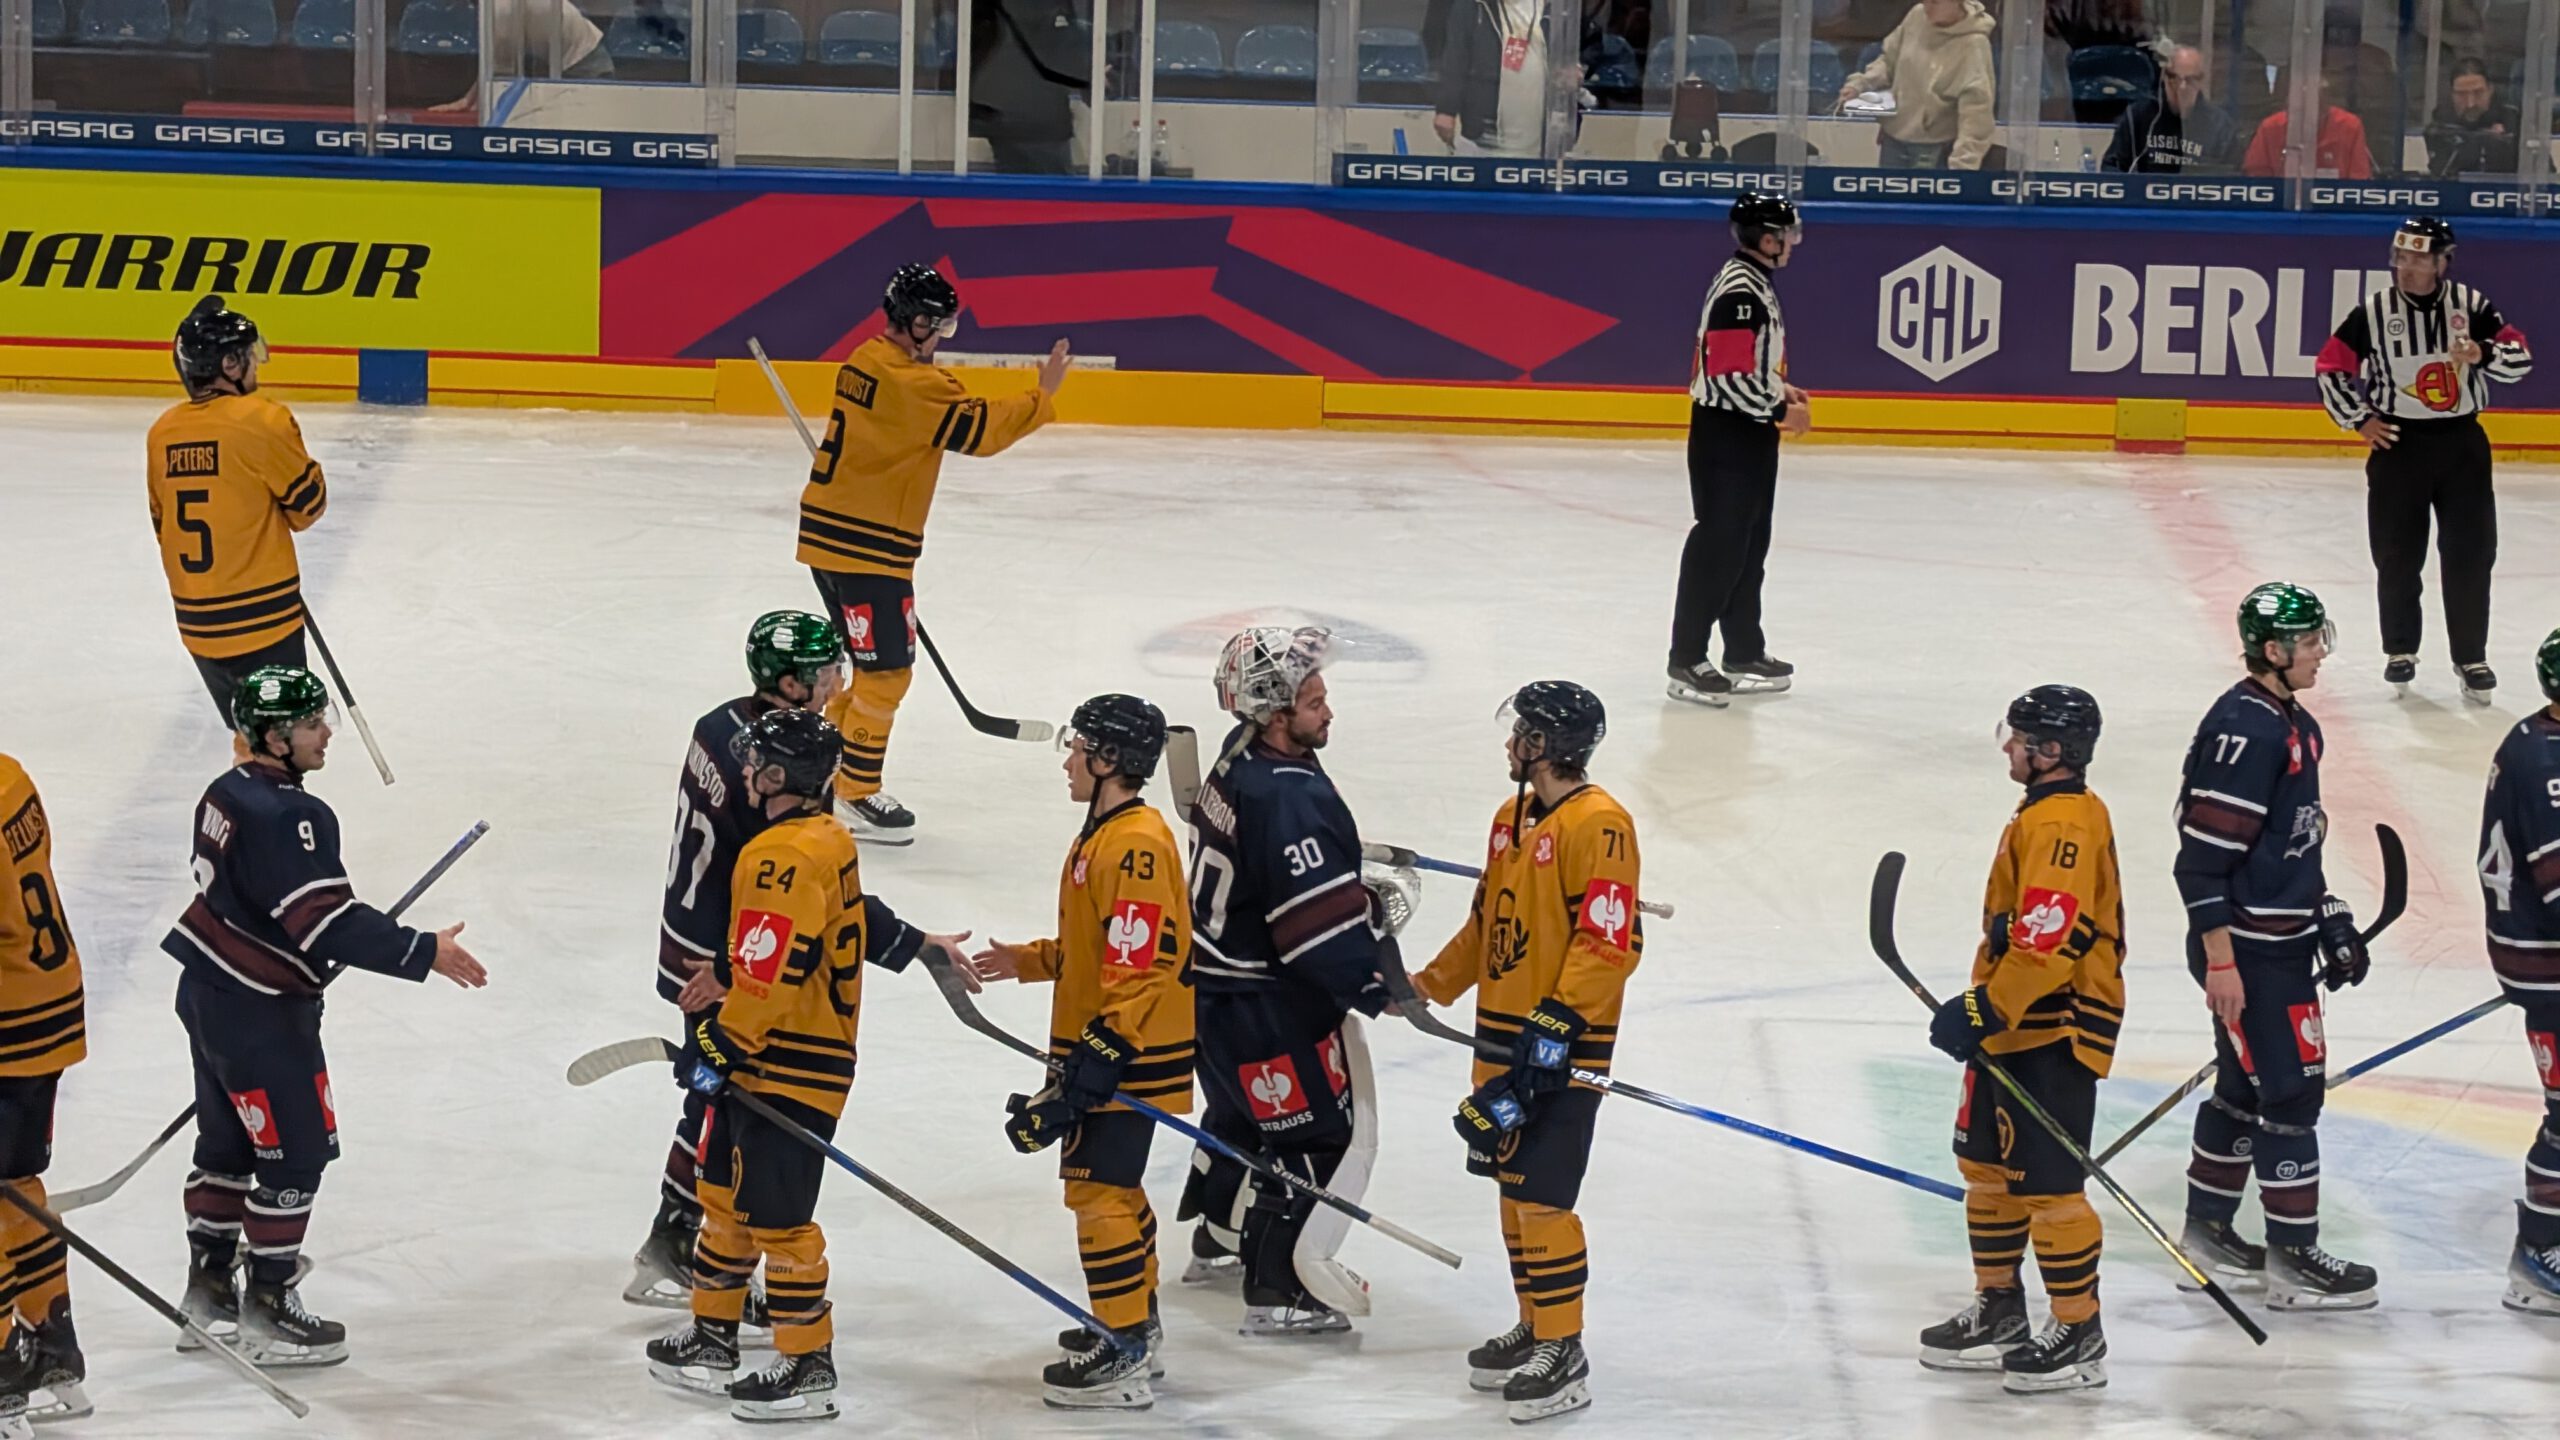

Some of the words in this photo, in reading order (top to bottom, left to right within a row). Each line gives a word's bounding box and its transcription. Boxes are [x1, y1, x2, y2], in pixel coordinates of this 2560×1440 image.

[0, 119, 134, 140] GASAG
[155, 124, 285, 146] GASAG
[315, 130, 453, 152] GASAG
[483, 135, 612, 157] GASAG
[1348, 162, 1475, 183] GASAG
[1495, 166, 1628, 188] GASAG
[1659, 170, 1787, 190] GASAG
[1833, 175, 1962, 196] GASAG
[1992, 179, 2125, 200] GASAG
[2146, 183, 2275, 203] GASAG
[2311, 187, 2440, 207] GASAG
[1737, 304, 1752, 320] 17
[1890, 264, 1990, 363] CHL
[2069, 263, 2395, 380] BERLI
[168, 446, 215, 473] PETERS
[176, 489, 214, 574] 5
[2547, 779, 2560, 808] 9
[298, 820, 316, 851] 9
[1602, 828, 1625, 862] 71
[1119, 848, 1155, 881] 43
[1283, 836, 1324, 877] 30
[2050, 838, 2079, 870] 18
[756, 859, 797, 895] 24
[1537, 1043, 1563, 1062] VK
[694, 1067, 717, 1090] VK
[1259, 1110, 1314, 1132] STRAUSS
